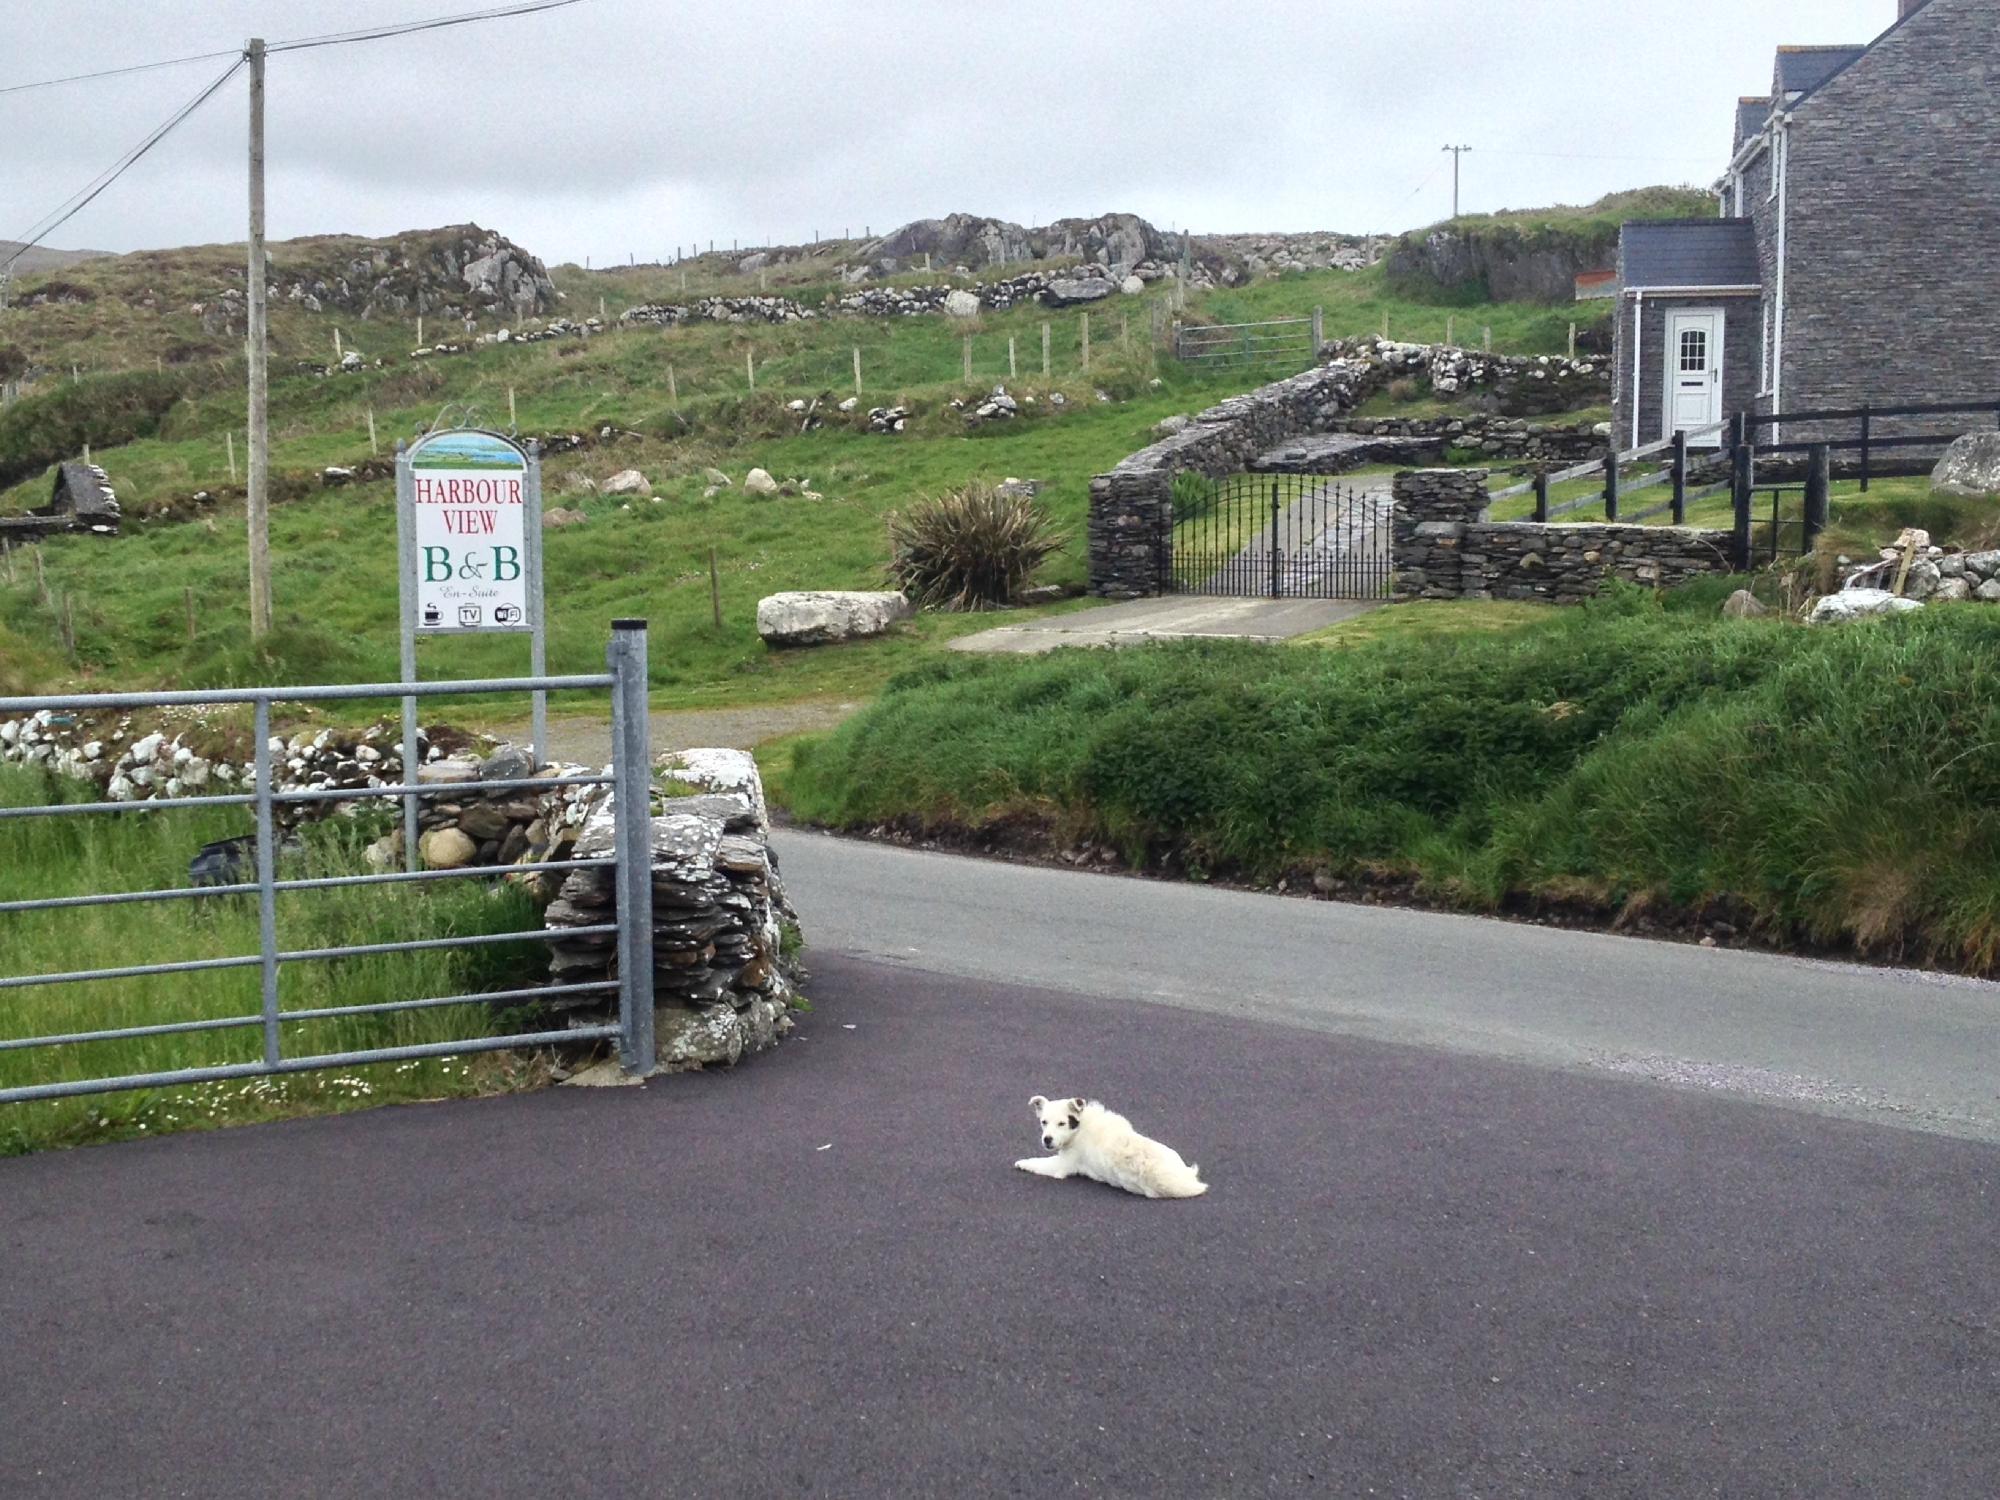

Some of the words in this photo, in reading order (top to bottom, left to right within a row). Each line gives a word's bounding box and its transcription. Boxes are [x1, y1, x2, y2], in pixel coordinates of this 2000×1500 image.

[416, 479, 523, 504] HARBOUR
[443, 509, 498, 534] VIEW
[439, 585, 500, 599] En-Suite
[462, 610, 478, 621] TV
